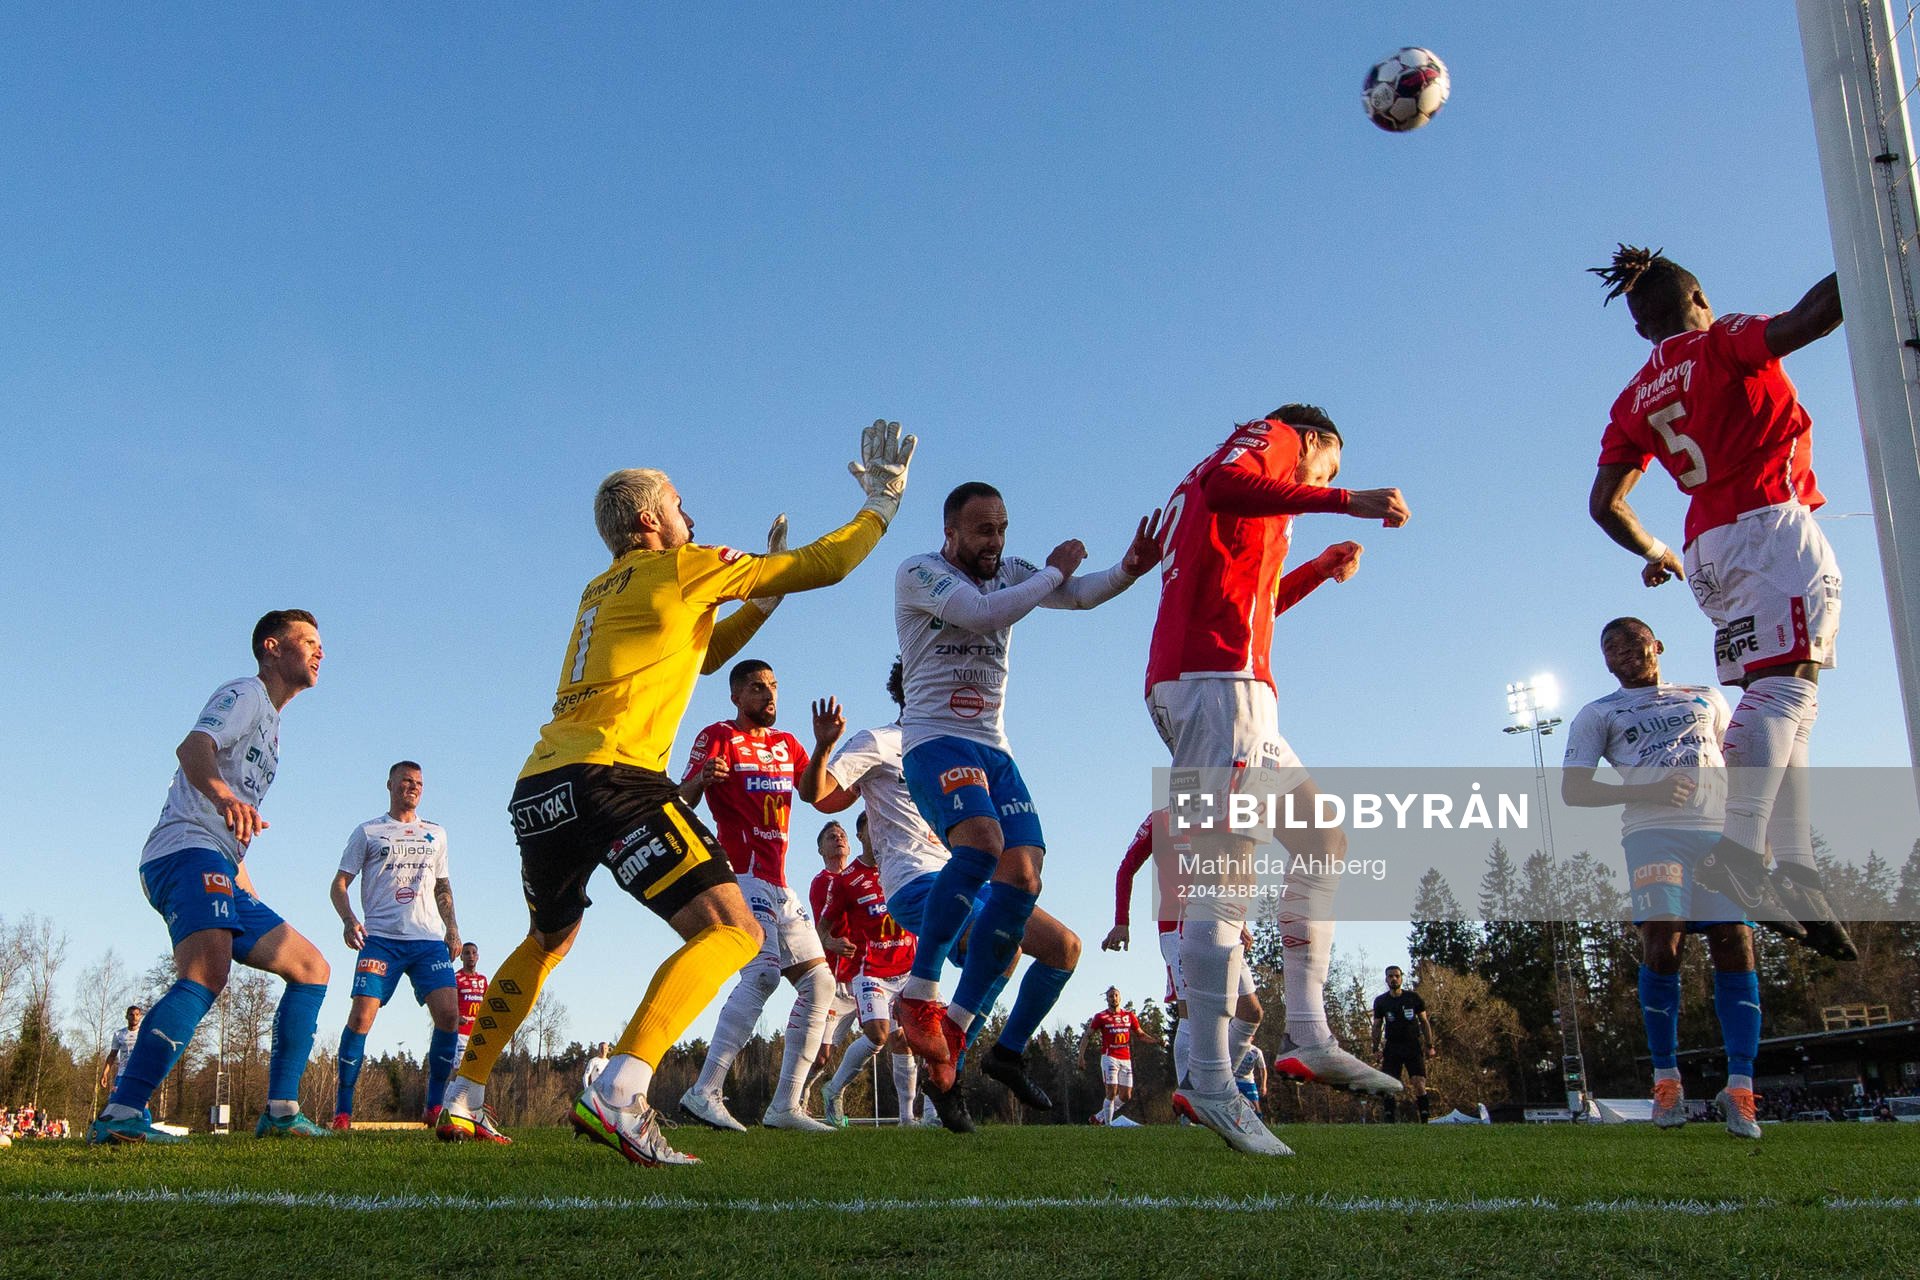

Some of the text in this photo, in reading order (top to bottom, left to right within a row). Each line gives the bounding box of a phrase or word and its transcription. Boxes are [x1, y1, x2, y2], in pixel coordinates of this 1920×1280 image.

[1648, 401, 1707, 488] 5
[1162, 493, 1186, 572] 2
[570, 604, 601, 684] 1
[1776, 624, 1785, 647] umbro
[747, 778, 792, 790] Helmia
[953, 794, 964, 810] 4
[665, 831, 682, 855] umbro
[617, 836, 667, 886] EMPE
[1634, 863, 1681, 882] ramo
[212, 900, 229, 918] 14
[1638, 892, 1651, 910] 21
[355, 976, 367, 988] 25
[866, 1002, 873, 1014] 8
